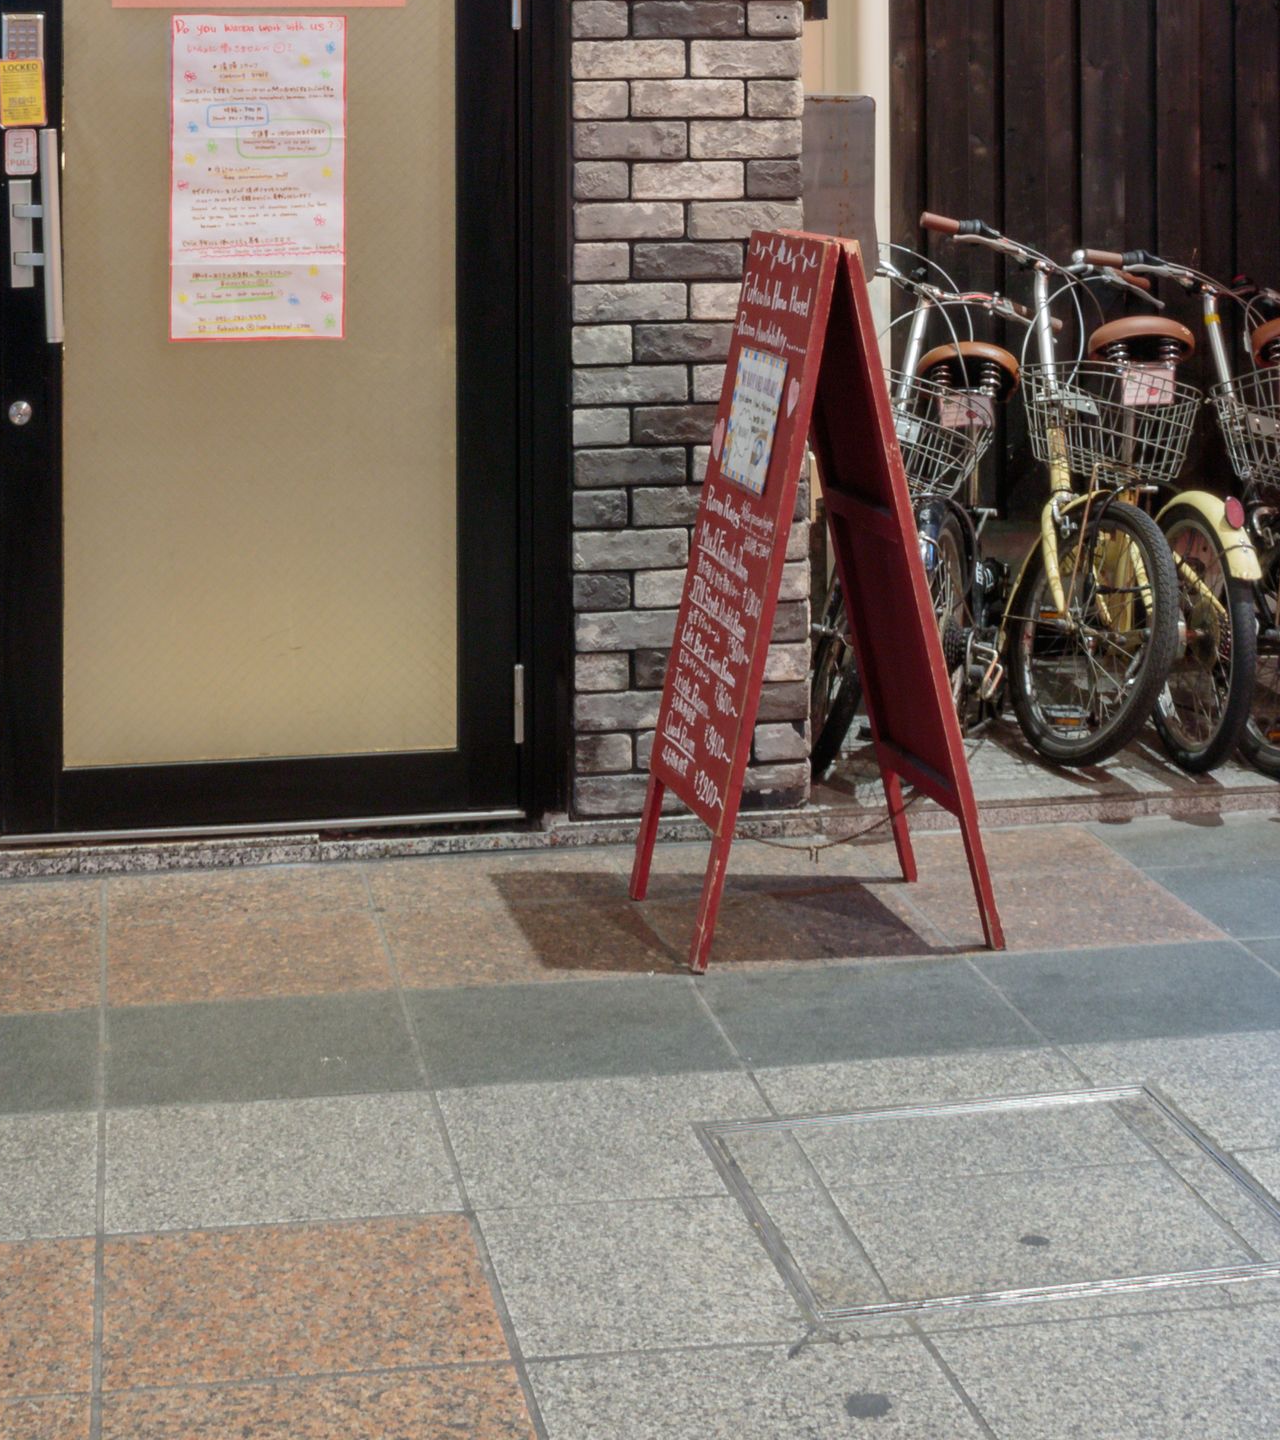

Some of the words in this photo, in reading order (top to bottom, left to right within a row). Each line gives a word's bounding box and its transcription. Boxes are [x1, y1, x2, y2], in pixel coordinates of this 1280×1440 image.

[175, 19, 190, 34] Do
[196, 24, 217, 36] you
[2, 63, 39, 73] LOCKED
